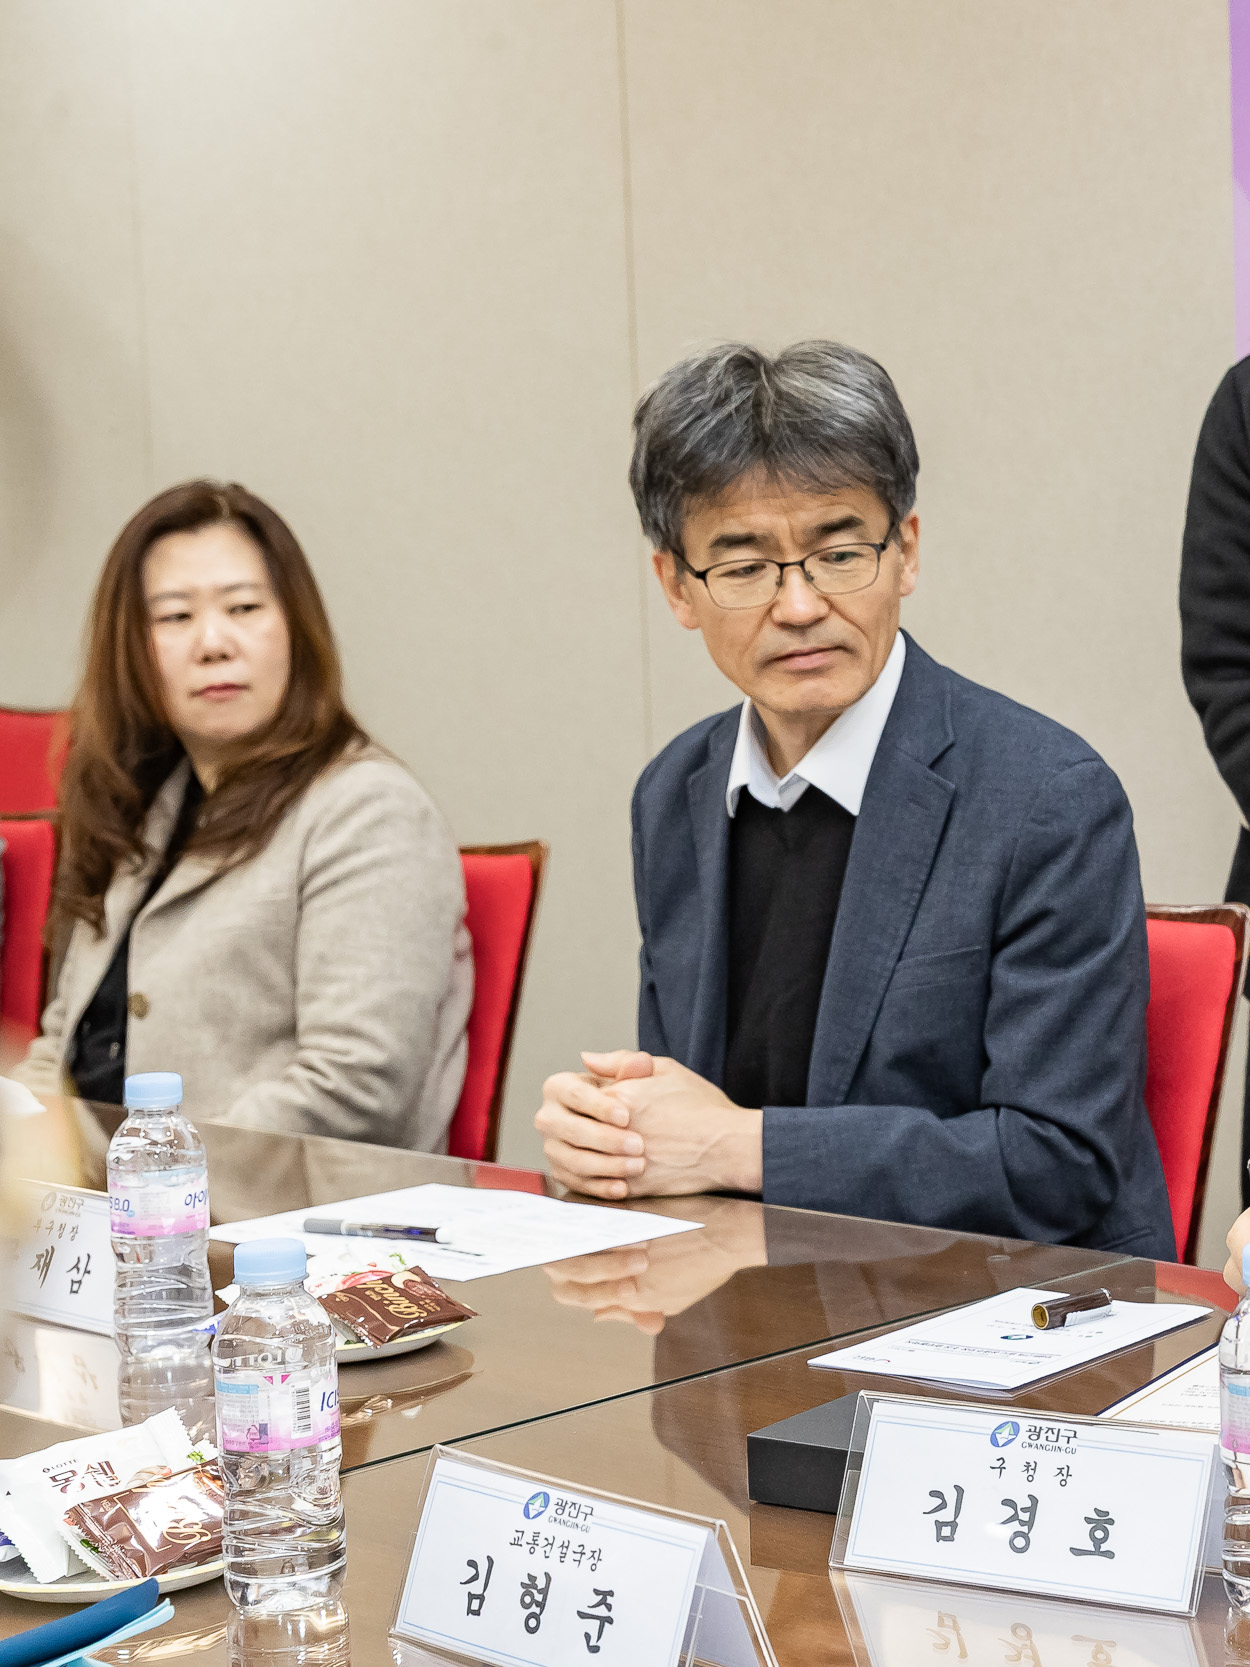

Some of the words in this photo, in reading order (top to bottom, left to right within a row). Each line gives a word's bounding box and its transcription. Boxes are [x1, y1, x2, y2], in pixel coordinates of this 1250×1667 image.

[1025, 1423, 1079, 1446] 광진구
[553, 1496, 594, 1522] 광진구
[508, 1528, 603, 1572] 교통건설국장
